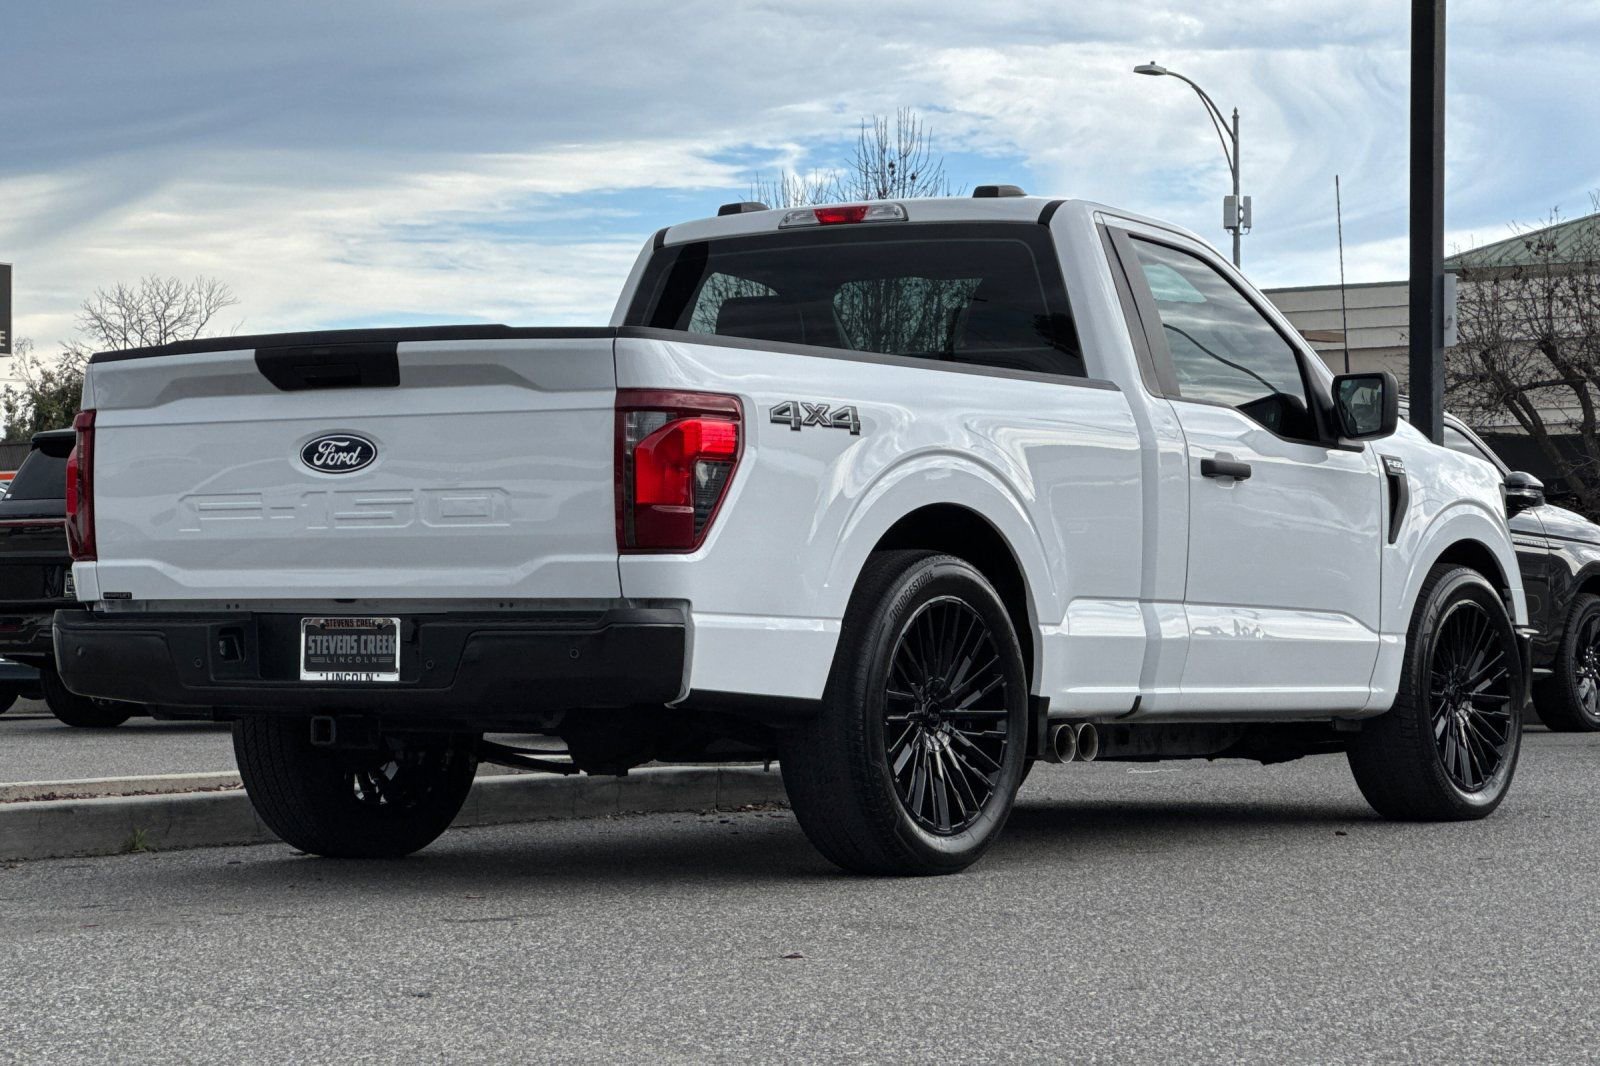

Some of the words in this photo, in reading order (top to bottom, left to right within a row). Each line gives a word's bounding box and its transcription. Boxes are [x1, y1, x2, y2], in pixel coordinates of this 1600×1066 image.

[313, 440, 361, 466] Ford
[179, 486, 512, 532] F-150
[325, 618, 355, 628] STEVENS
[307, 635, 358, 655] STEVENS
[360, 635, 396, 655] CREEK
[326, 656, 378, 664] LINCOLN
[325, 672, 374, 681] LINCOLN
